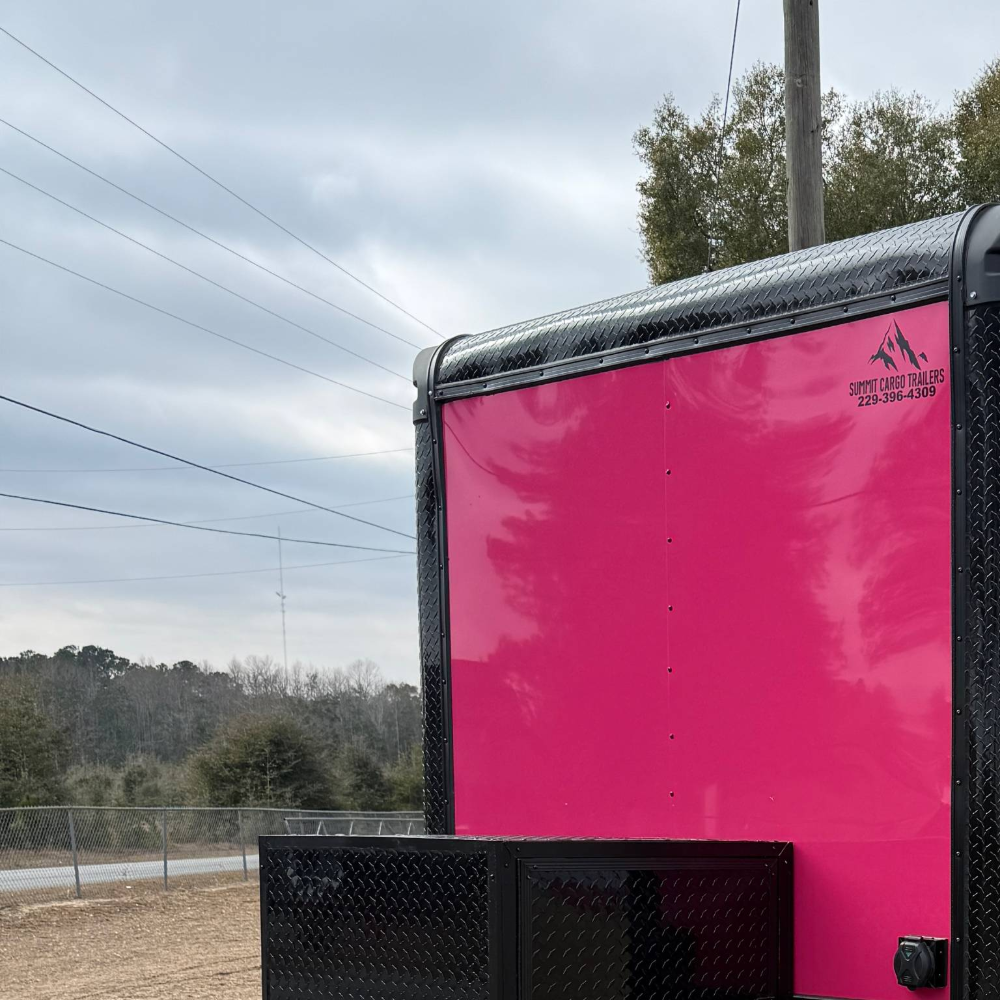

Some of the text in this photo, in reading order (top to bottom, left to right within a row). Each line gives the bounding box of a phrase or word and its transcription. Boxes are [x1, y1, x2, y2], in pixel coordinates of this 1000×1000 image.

[849, 368, 945, 396] SUMMIT CARGO TRAILERS
[857, 385, 936, 407] 229-396-4309
